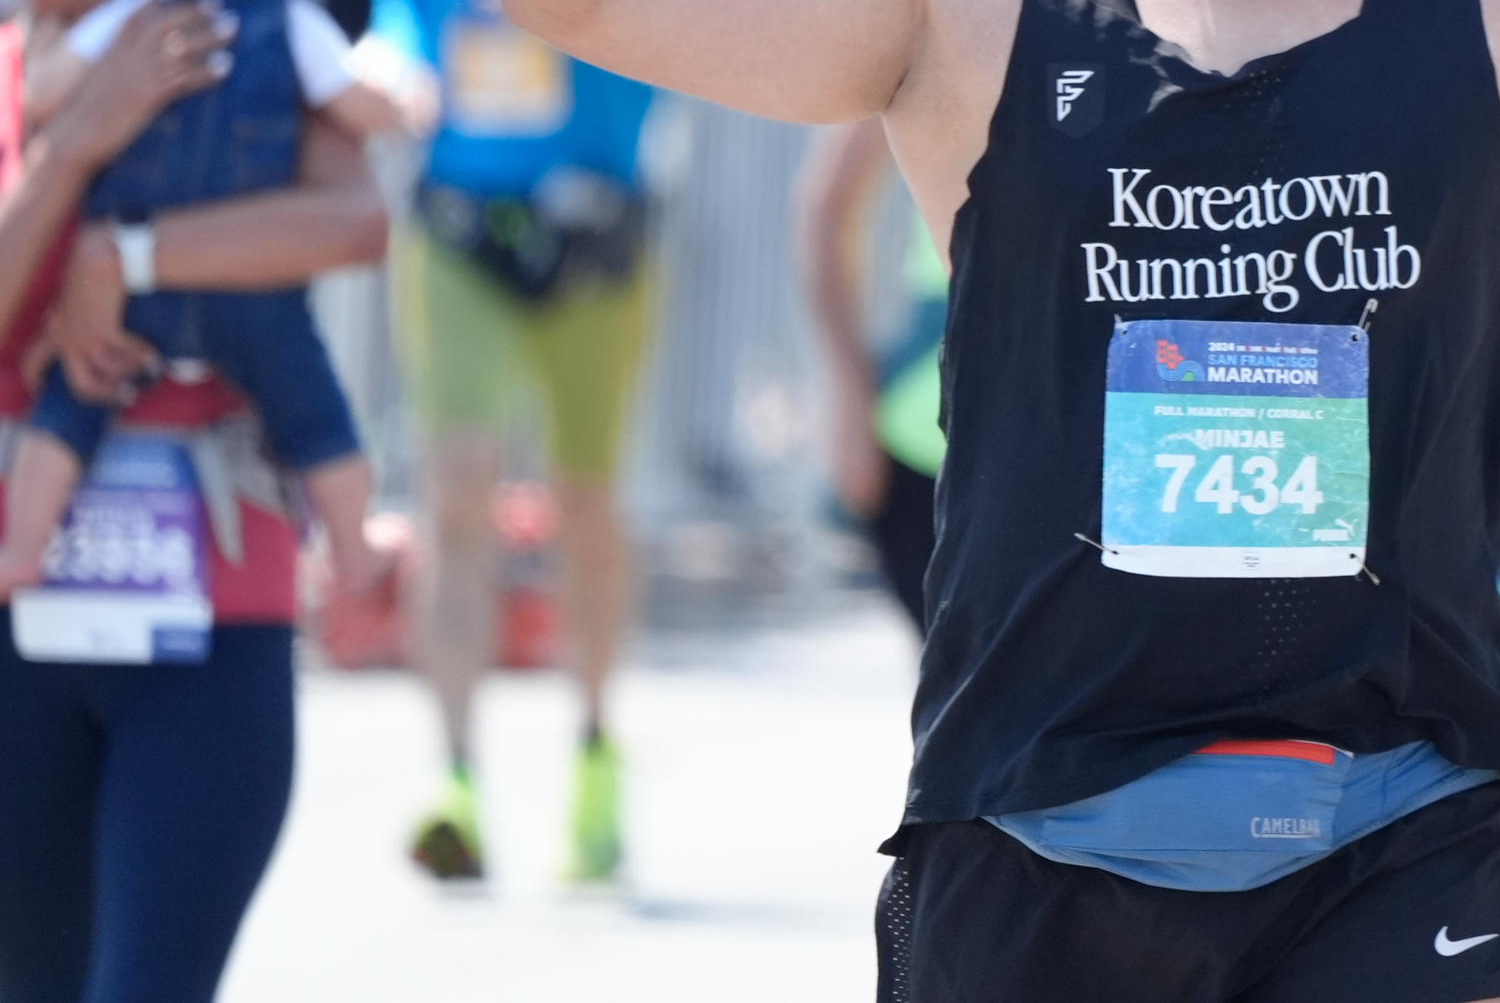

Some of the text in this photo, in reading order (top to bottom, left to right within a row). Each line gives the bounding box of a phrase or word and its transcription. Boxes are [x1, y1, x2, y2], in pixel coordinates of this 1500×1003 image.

[1107, 167, 1392, 231] Koreatown
[1080, 226, 1421, 313] Running Club
[1207, 354, 1319, 369] SAN FRANCISCO
[1207, 366, 1319, 385] MARATHON
[1154, 406, 1186, 416] FULL
[1187, 406, 1256, 418] MARATHON
[1266, 408, 1314, 420] CORRAL
[1315, 410, 1324, 420] C
[1194, 429, 1285, 449] MINJAE
[1154, 454, 1324, 515] 7434
